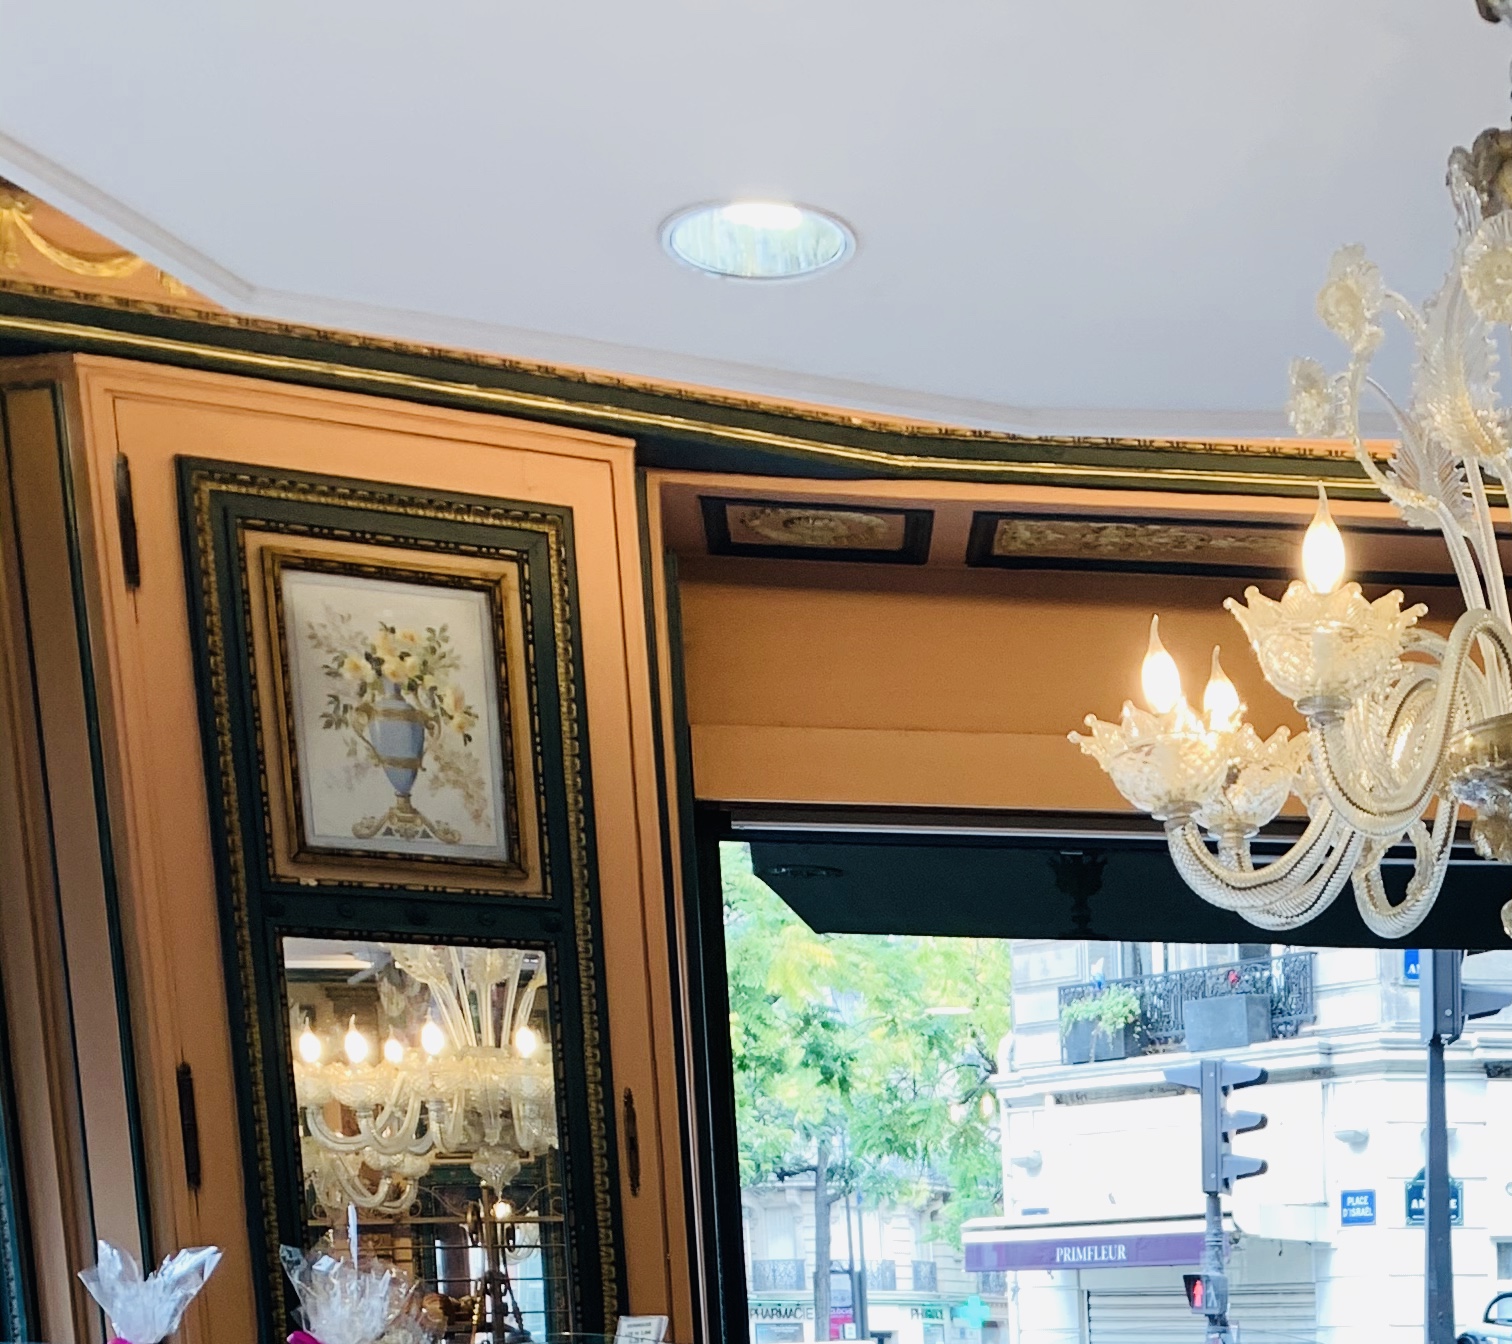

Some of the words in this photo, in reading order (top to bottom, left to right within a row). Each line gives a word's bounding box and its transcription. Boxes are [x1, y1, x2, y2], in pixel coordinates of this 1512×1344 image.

[1346, 1195, 1369, 1206] PLACE
[1055, 1244, 1127, 1263] PRIMFLEUR
[750, 1306, 814, 1321] PHARMACIE
